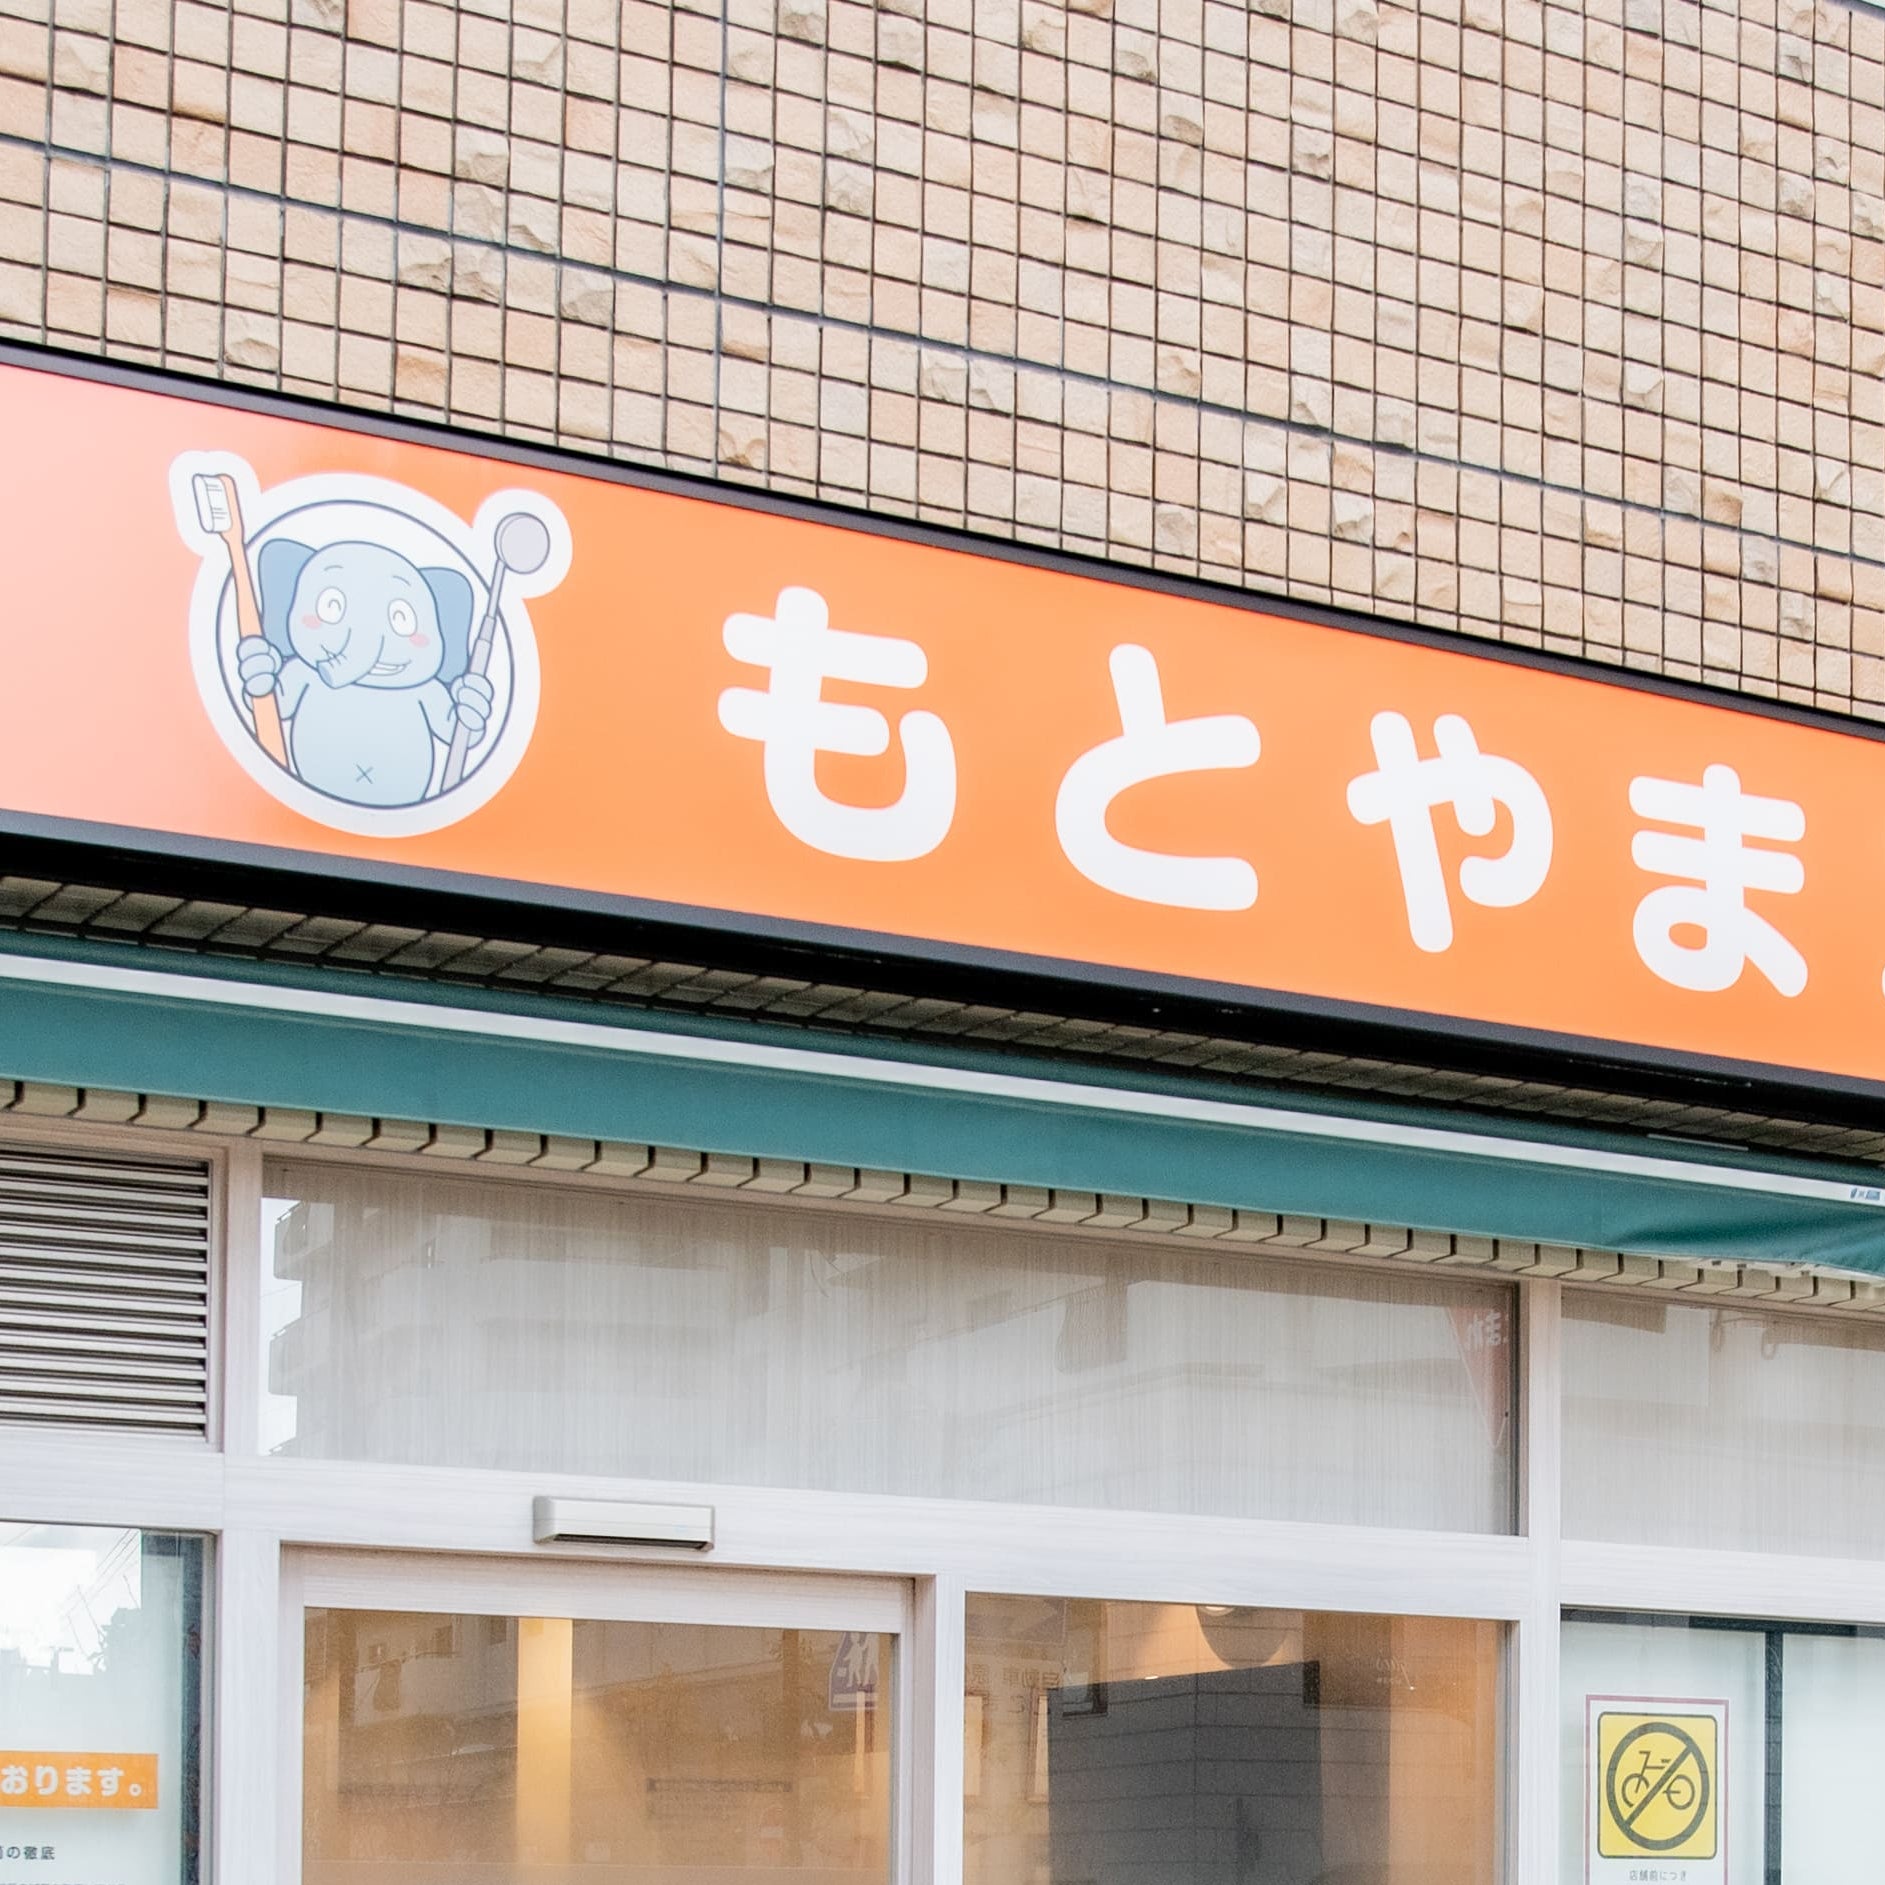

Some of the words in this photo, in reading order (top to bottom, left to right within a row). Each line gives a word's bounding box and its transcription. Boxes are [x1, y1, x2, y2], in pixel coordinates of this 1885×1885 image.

[0, 1764, 142, 1797] おります。
[0, 1846, 56, 1860] の徹底
